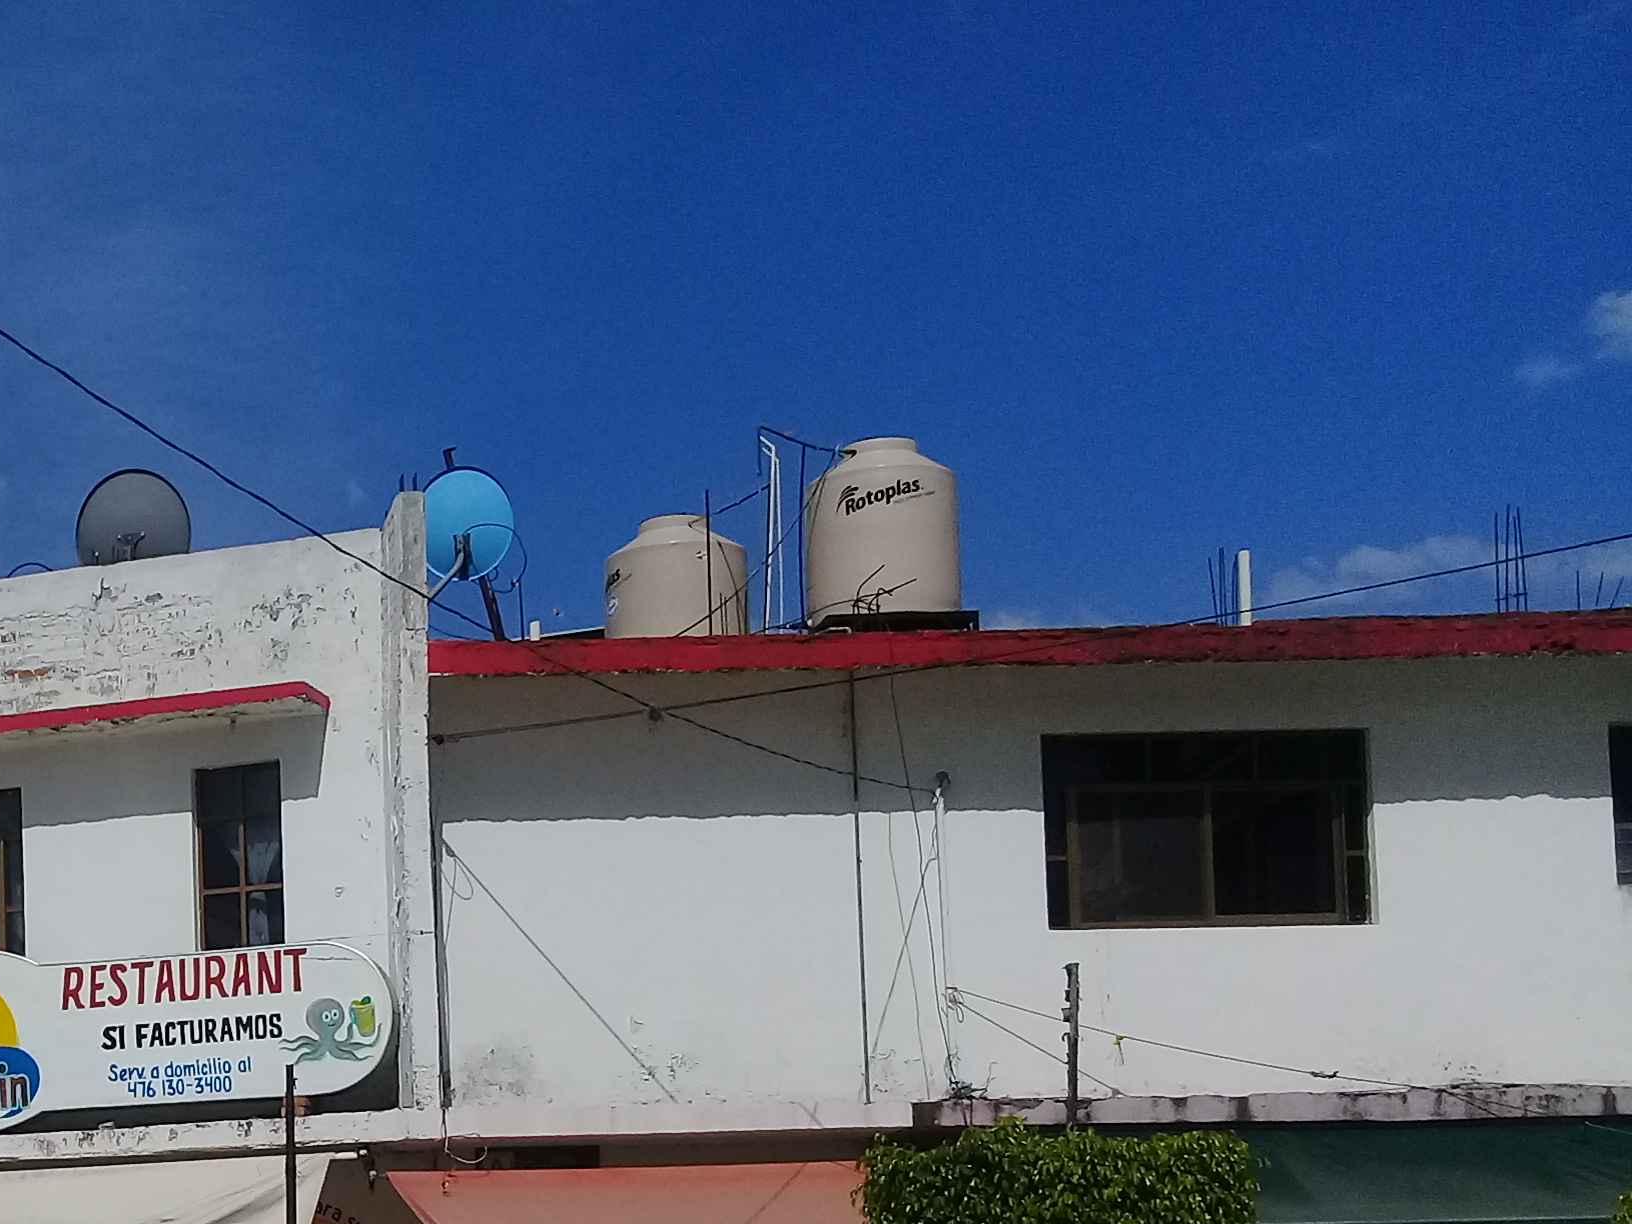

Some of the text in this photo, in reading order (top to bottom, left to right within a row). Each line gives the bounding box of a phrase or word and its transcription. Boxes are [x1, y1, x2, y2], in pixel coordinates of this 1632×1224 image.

[845, 478, 921, 516] Rotoplas
[61, 947, 308, 1011] RESTAURANT
[100, 1013, 284, 1051] SI FACTURAMOS
[150, 1065, 160, 1079] a
[164, 1057, 232, 1078] domicilio
[237, 1055, 252, 1073] al
[127, 1075, 233, 1098] 476 130-3400
